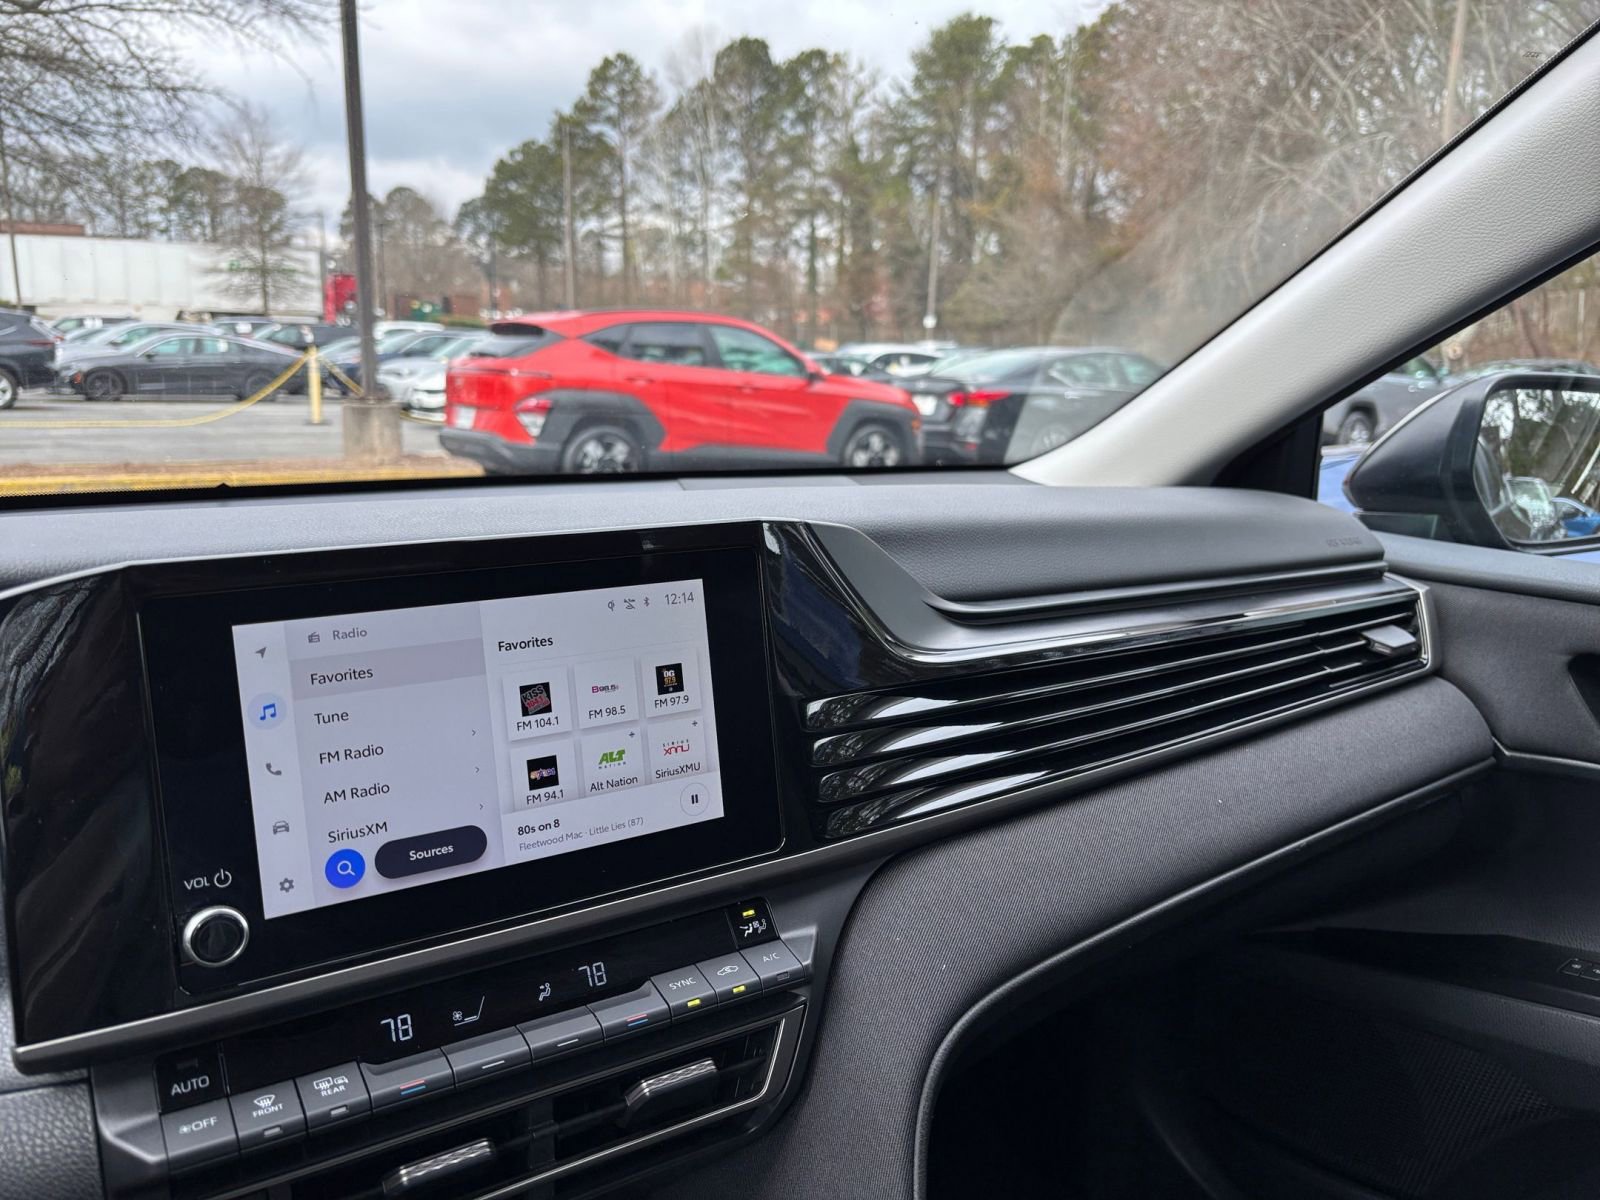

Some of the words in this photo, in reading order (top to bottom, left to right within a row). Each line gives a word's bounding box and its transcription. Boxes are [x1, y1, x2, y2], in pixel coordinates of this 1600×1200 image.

[664, 592, 695, 606] 12:14
[332, 627, 368, 641] Radio
[497, 636, 554, 652] Favorites
[310, 667, 374, 685] Favorites
[654, 698, 668, 709] FM
[670, 695, 689, 707] 97.9
[314, 709, 350, 726] Tune
[588, 709, 603, 720] FM
[605, 705, 626, 717] 98.5
[516, 721, 532, 731] FM
[534, 716, 559, 729] 104.1
[319, 750, 340, 765] FM
[344, 744, 384, 760] Radio
[598, 749, 625, 765] ALT
[655, 762, 701, 779] SiriusXMU
[590, 781, 604, 792] Alt
[605, 775, 638, 789] Nation
[324, 789, 347, 804] AM
[350, 782, 390, 799] Radio
[526, 795, 542, 805] FM
[544, 790, 564, 801] 94.1
[328, 821, 388, 843] SiriusXM
[517, 824, 536, 836] 80s
[538, 822, 552, 832] on
[553, 818, 561, 829] 8
[519, 834, 564, 852] Fleetwood
[565, 831, 583, 842] Mac
[589, 825, 610, 836] Little
[611, 821, 626, 832] Lies
[628, 817, 644, 829] (87)
[409, 843, 454, 861] Sources
[184, 876, 210, 891] VOL
[762, 952, 781, 963] A/C
[578, 962, 607, 988] 78
[668, 976, 697, 990] SYNC
[380, 1013, 413, 1043] 78
[171, 1075, 210, 1096] AUTO
[321, 1085, 346, 1097] REAR
[252, 1103, 283, 1118] FRONT
[191, 1117, 218, 1131] OFF
